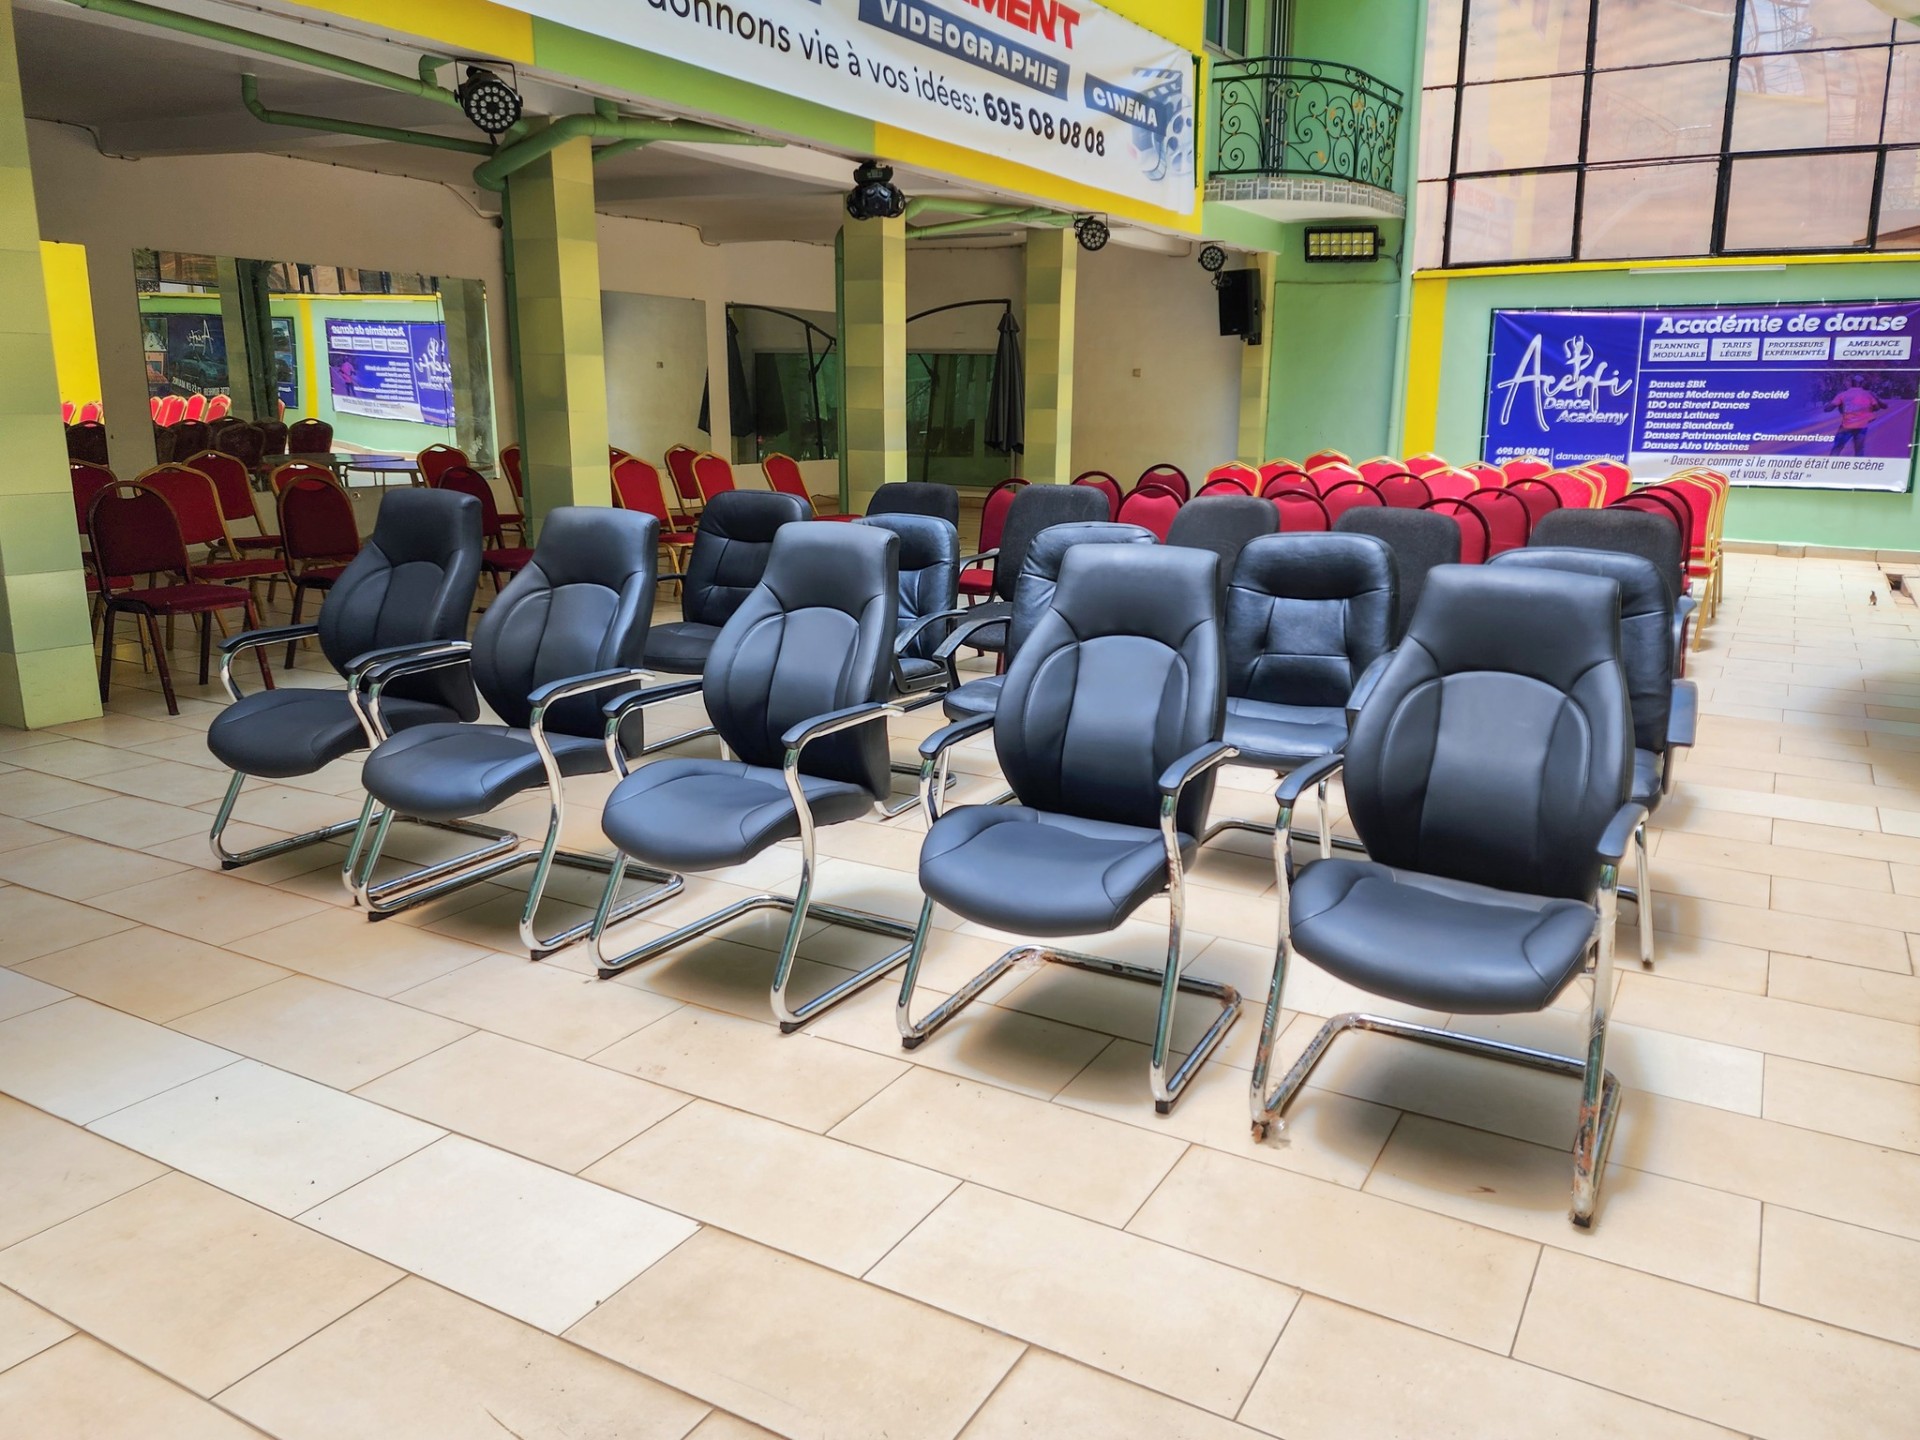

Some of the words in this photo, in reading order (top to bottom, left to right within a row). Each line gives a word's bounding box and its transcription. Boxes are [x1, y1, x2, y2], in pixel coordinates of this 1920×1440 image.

[962, 0, 1081, 50] ENT
[880, 0, 1059, 89] VIDEOGRAPHIE
[798, 28, 840, 70] vie
[845, 40, 862, 78] à
[867, 58, 910, 94] vos
[913, 66, 979, 117] idées:
[983, 91, 1025, 131] 695
[1028, 107, 1055, 140] 08
[1059, 116, 1082, 149] 08
[1084, 126, 1106, 157] 08
[1092, 86, 1159, 128] CINEMA
[1655, 314, 1783, 335] Académie
[1786, 313, 1821, 333] de
[1824, 312, 1908, 332] danse
[1653, 342, 1700, 350] PLANNING
[1722, 341, 1753, 349] TARIFS
[1719, 349, 1753, 358] LÉGERS
[1764, 348, 1826, 356] EXPÉRIMENTÉS
[1842, 349, 1904, 357] CONVIVIALE
[1497, 333, 1633, 431] Acerfi
[1648, 380, 1686, 389] Danses
[1686, 380, 1707, 389] SBK
[1647, 390, 1685, 399] Danses
[1685, 390, 1736, 399] Modernes
[1736, 390, 1750, 399] de
[1751, 390, 1790, 400] Société
[1544, 397, 1591, 410] Dance
[1682, 400, 1711, 409] Street
[1711, 401, 1750, 410] Dances
[1556, 410, 1629, 426] Academy
[1645, 411, 1682, 419] Danses
[1683, 411, 1720, 420] Latines
[1644, 421, 1681, 429] Danses
[1682, 421, 1735, 430] Standards
[1643, 431, 1681, 440] Danses
[1681, 431, 1751, 441] Patrimoniales
[1752, 432, 1836, 442] Camerounaises
[1496, 446, 1513, 455] 695
[1514, 447, 1525, 455] 08
[1526, 447, 1538, 456] 08
[1538, 447, 1550, 456] 08
[1642, 441, 1680, 450] Danses
[1680, 441, 1702, 450] Afro
[1702, 442, 1750, 451] Urbaines
[1670, 455, 1705, 466] Dansez
[1706, 457, 1743, 467] comme
[1745, 456, 1756, 467] si
[1756, 456, 1766, 467] le
[1767, 457, 1803, 468] monde
[1804, 457, 1830, 469] était
[1831, 460, 1851, 470] une
[1852, 459, 1885, 471] scène
[1729, 469, 1741, 479] et
[1743, 469, 1769, 480] vous,
[1771, 469, 1781, 480] la
[1782, 470, 1804, 480] star
